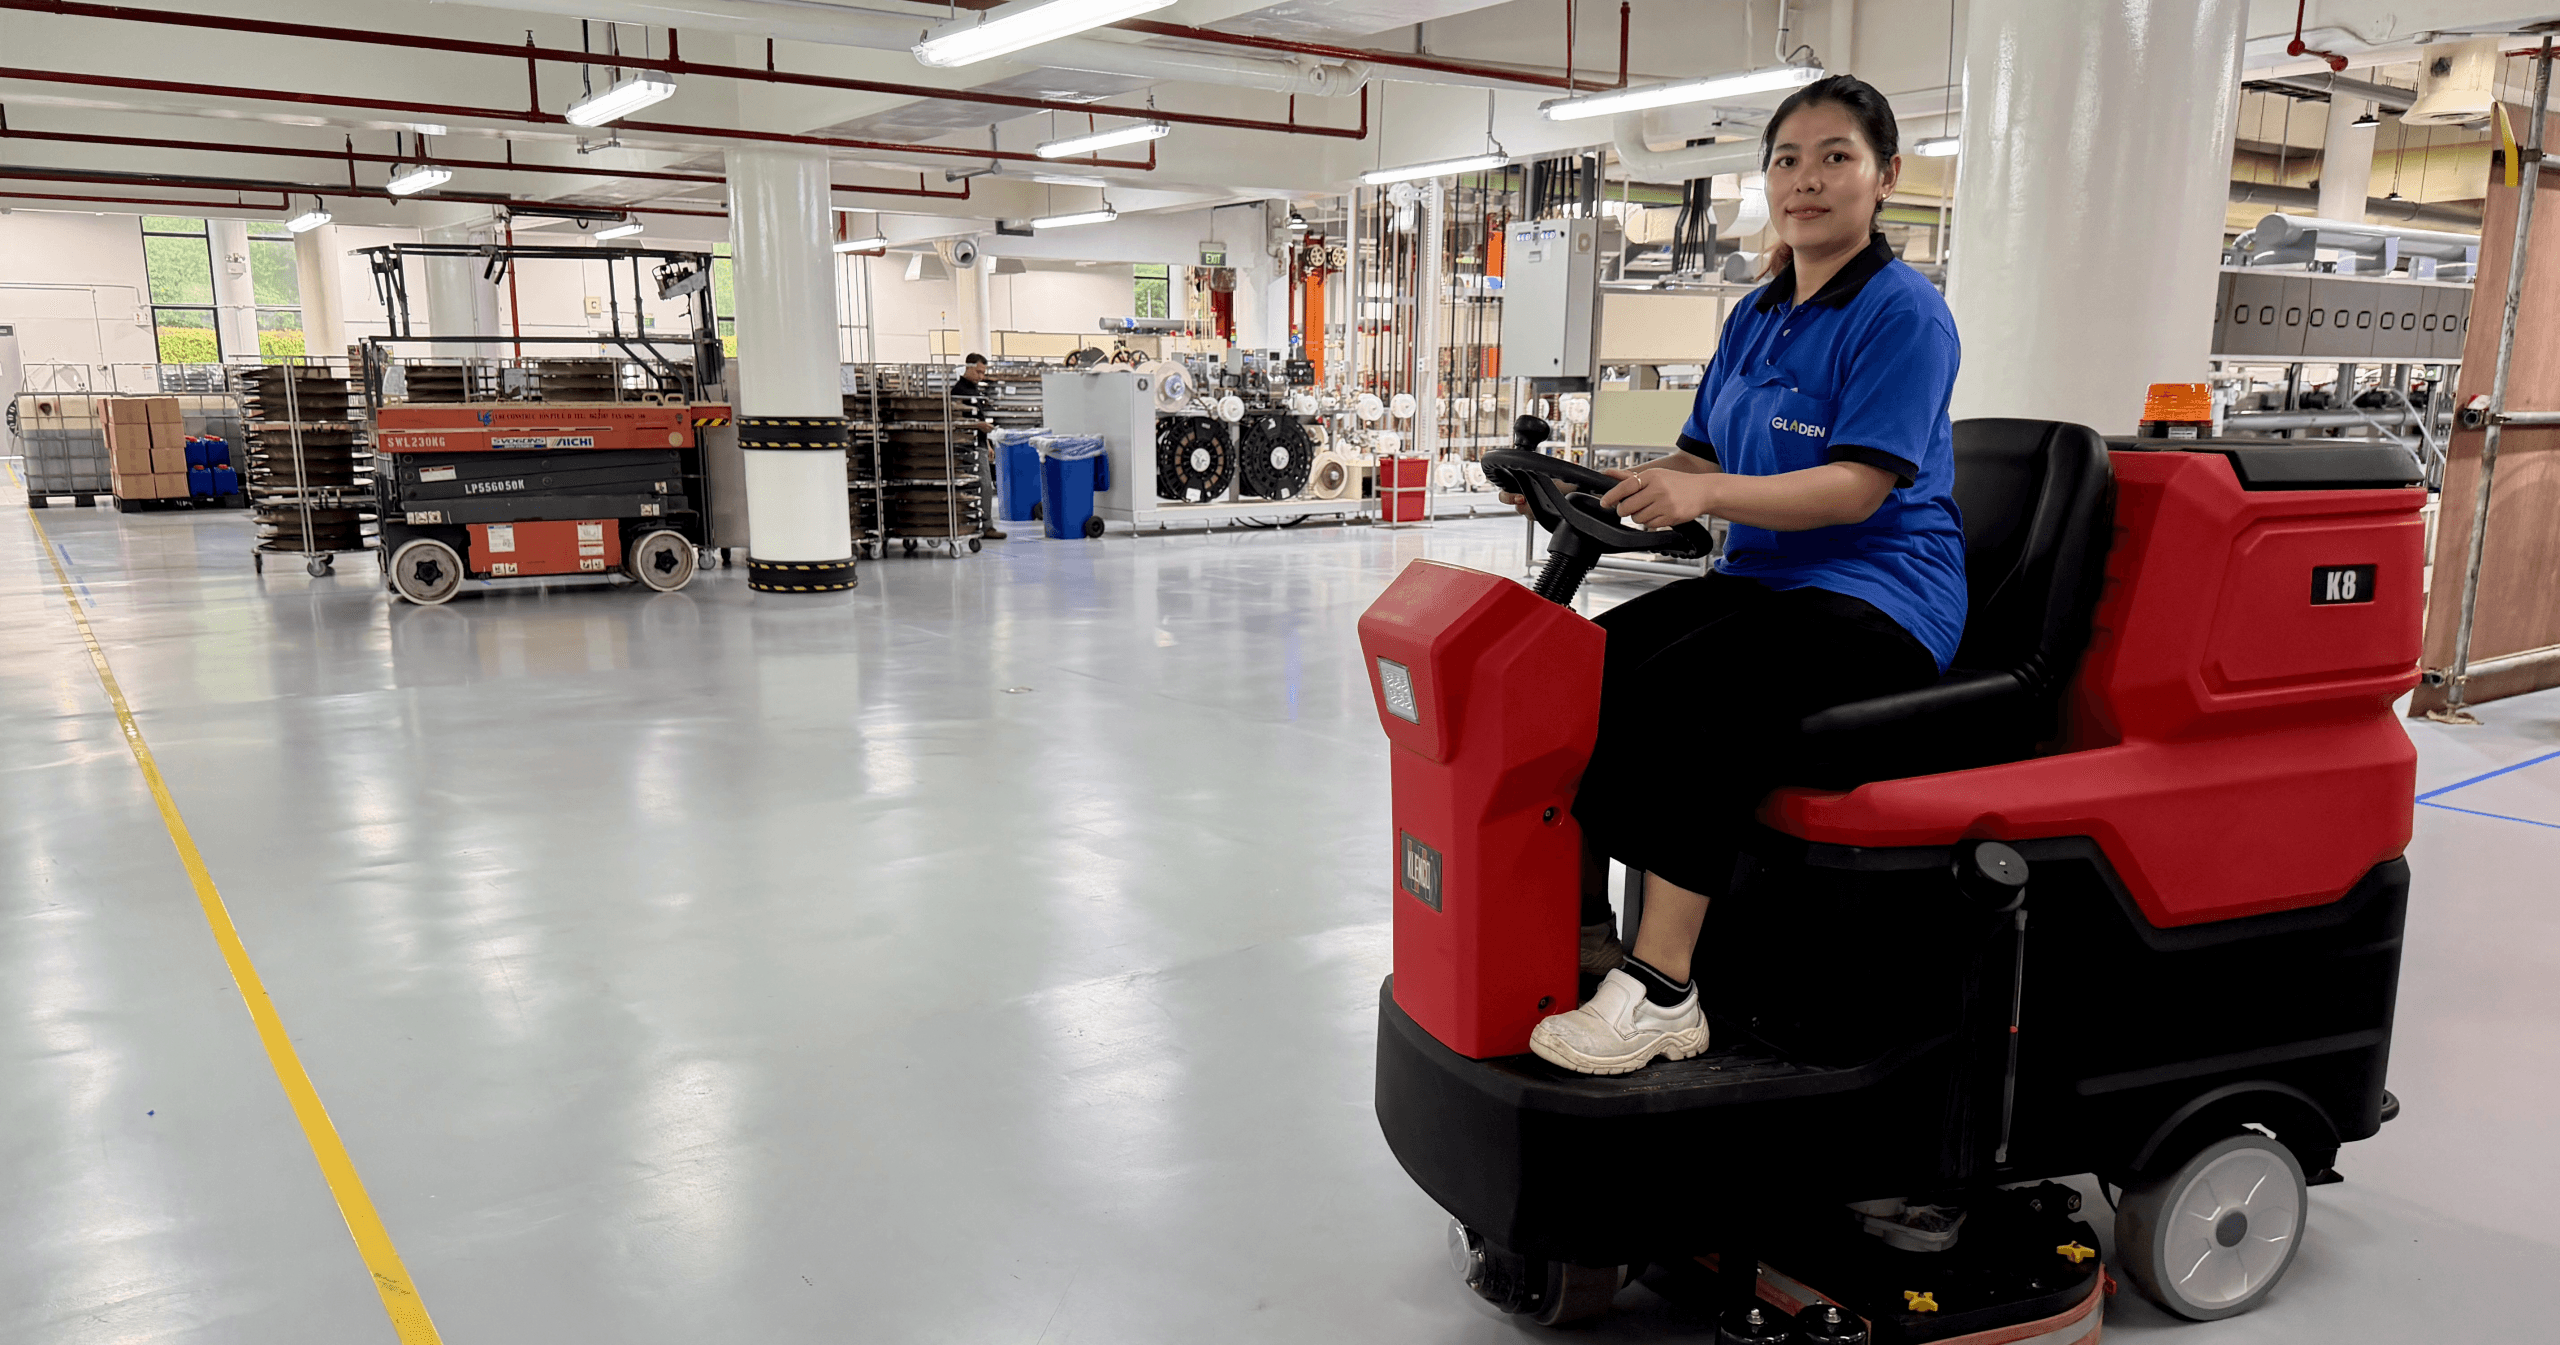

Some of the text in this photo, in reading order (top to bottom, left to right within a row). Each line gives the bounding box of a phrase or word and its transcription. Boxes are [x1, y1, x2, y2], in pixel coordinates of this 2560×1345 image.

[1205, 253, 1221, 264] EXIT
[1771, 416, 1826, 438] GLADEN
[387, 436, 446, 448] SWL230KG
[556, 437, 592, 447] AICHI
[464, 479, 525, 495] LP556050K
[2325, 570, 2357, 601] K8
